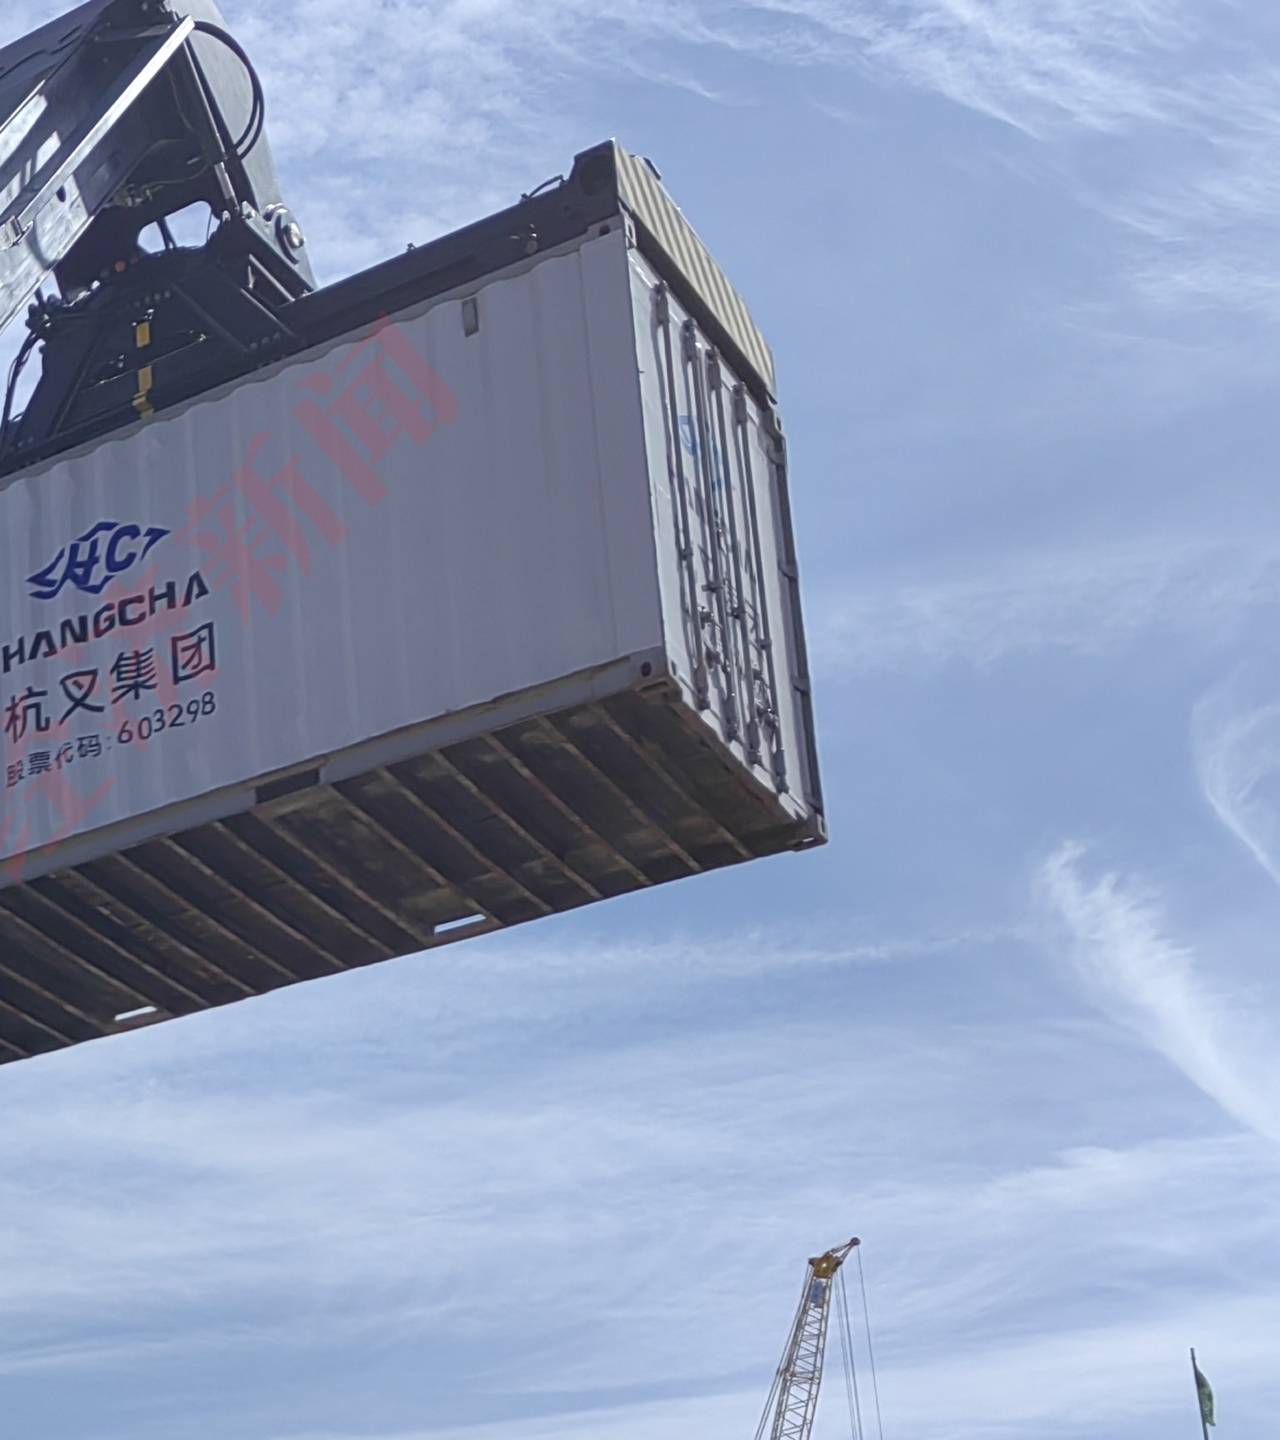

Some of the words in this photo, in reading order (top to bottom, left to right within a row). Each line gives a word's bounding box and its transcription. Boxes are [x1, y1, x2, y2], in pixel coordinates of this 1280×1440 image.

[1, 570, 210, 673] HANGCHA
[4, 622, 215, 744] 杭叉集团
